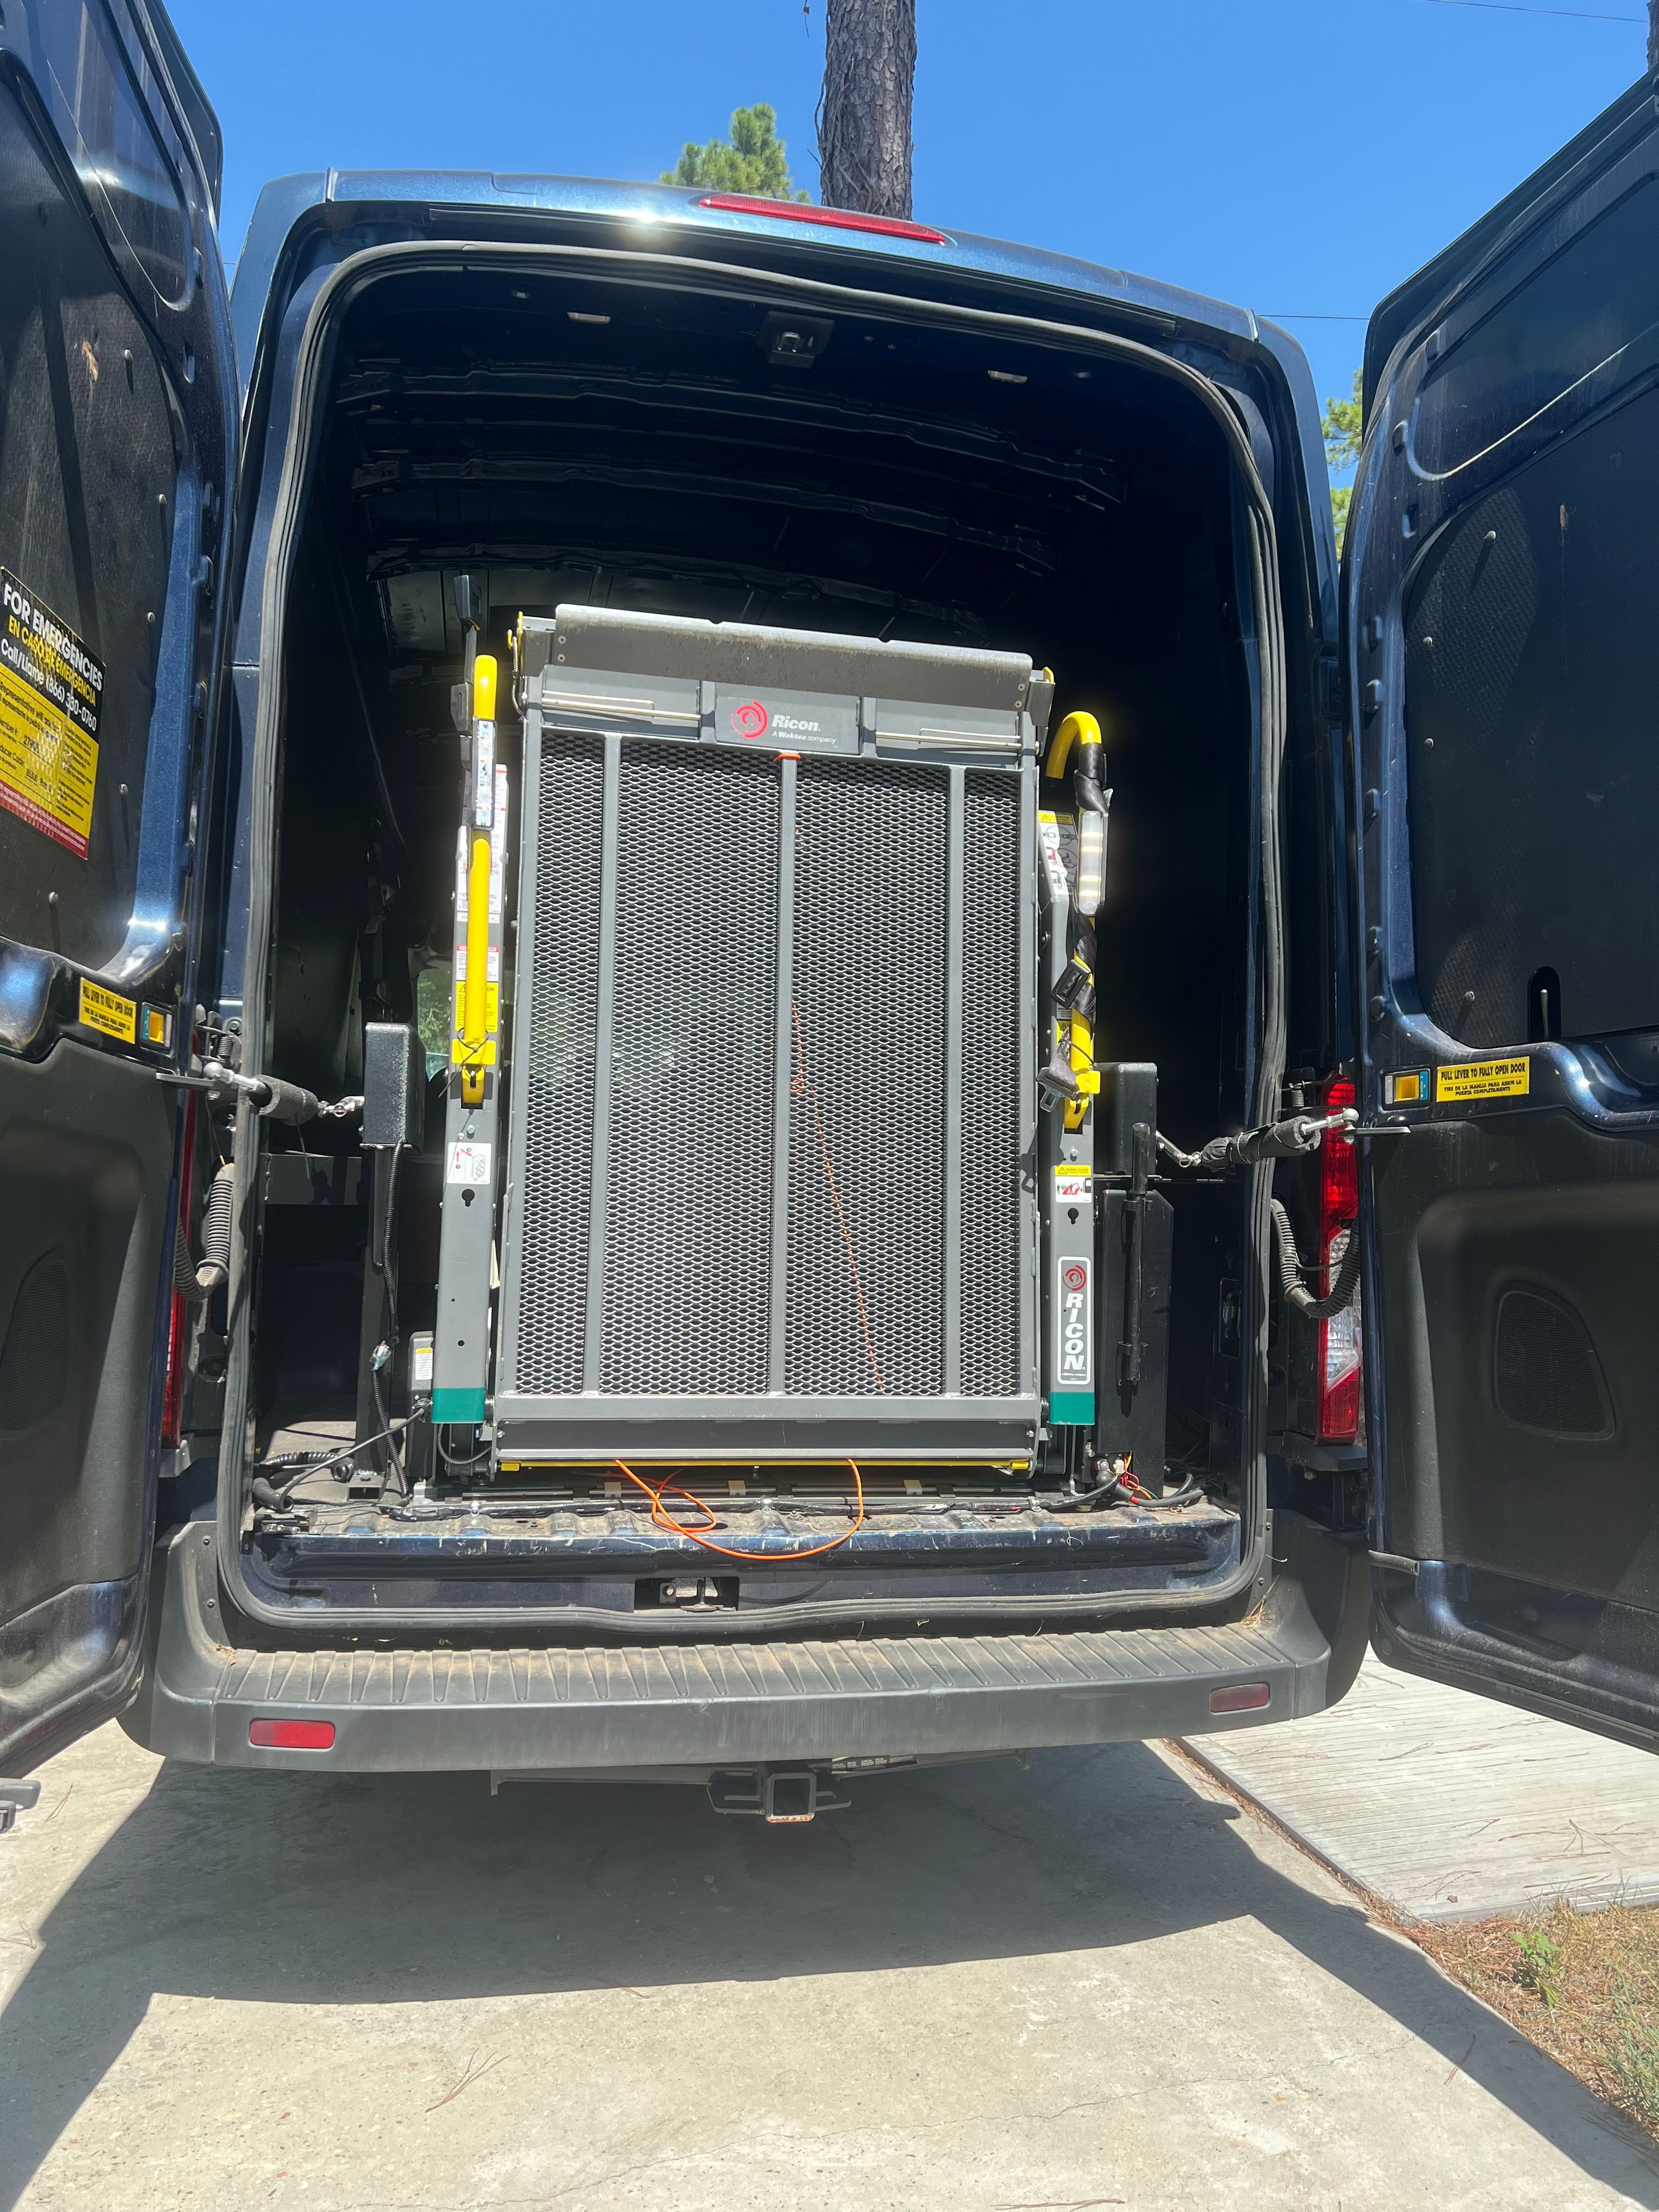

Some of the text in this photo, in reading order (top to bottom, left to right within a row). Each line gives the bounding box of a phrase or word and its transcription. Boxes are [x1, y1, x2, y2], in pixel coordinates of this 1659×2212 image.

[4, 583, 103, 691] FOR EMERGENCIES
[9, 614, 20, 638] EN
[55, 656, 95, 707] EMERGENCIA
[1, 638, 44, 685] Call/Llame
[46, 675, 65, 703] (866)
[772, 714, 819, 731] Ricon
[778, 731, 806, 740] Wabtec
[807, 736, 836, 744] company
[1441, 1062, 1525, 1081] PULL LEVER TO FULLY OPEN DOOR
[1064, 1293, 1084, 1370] RICON
